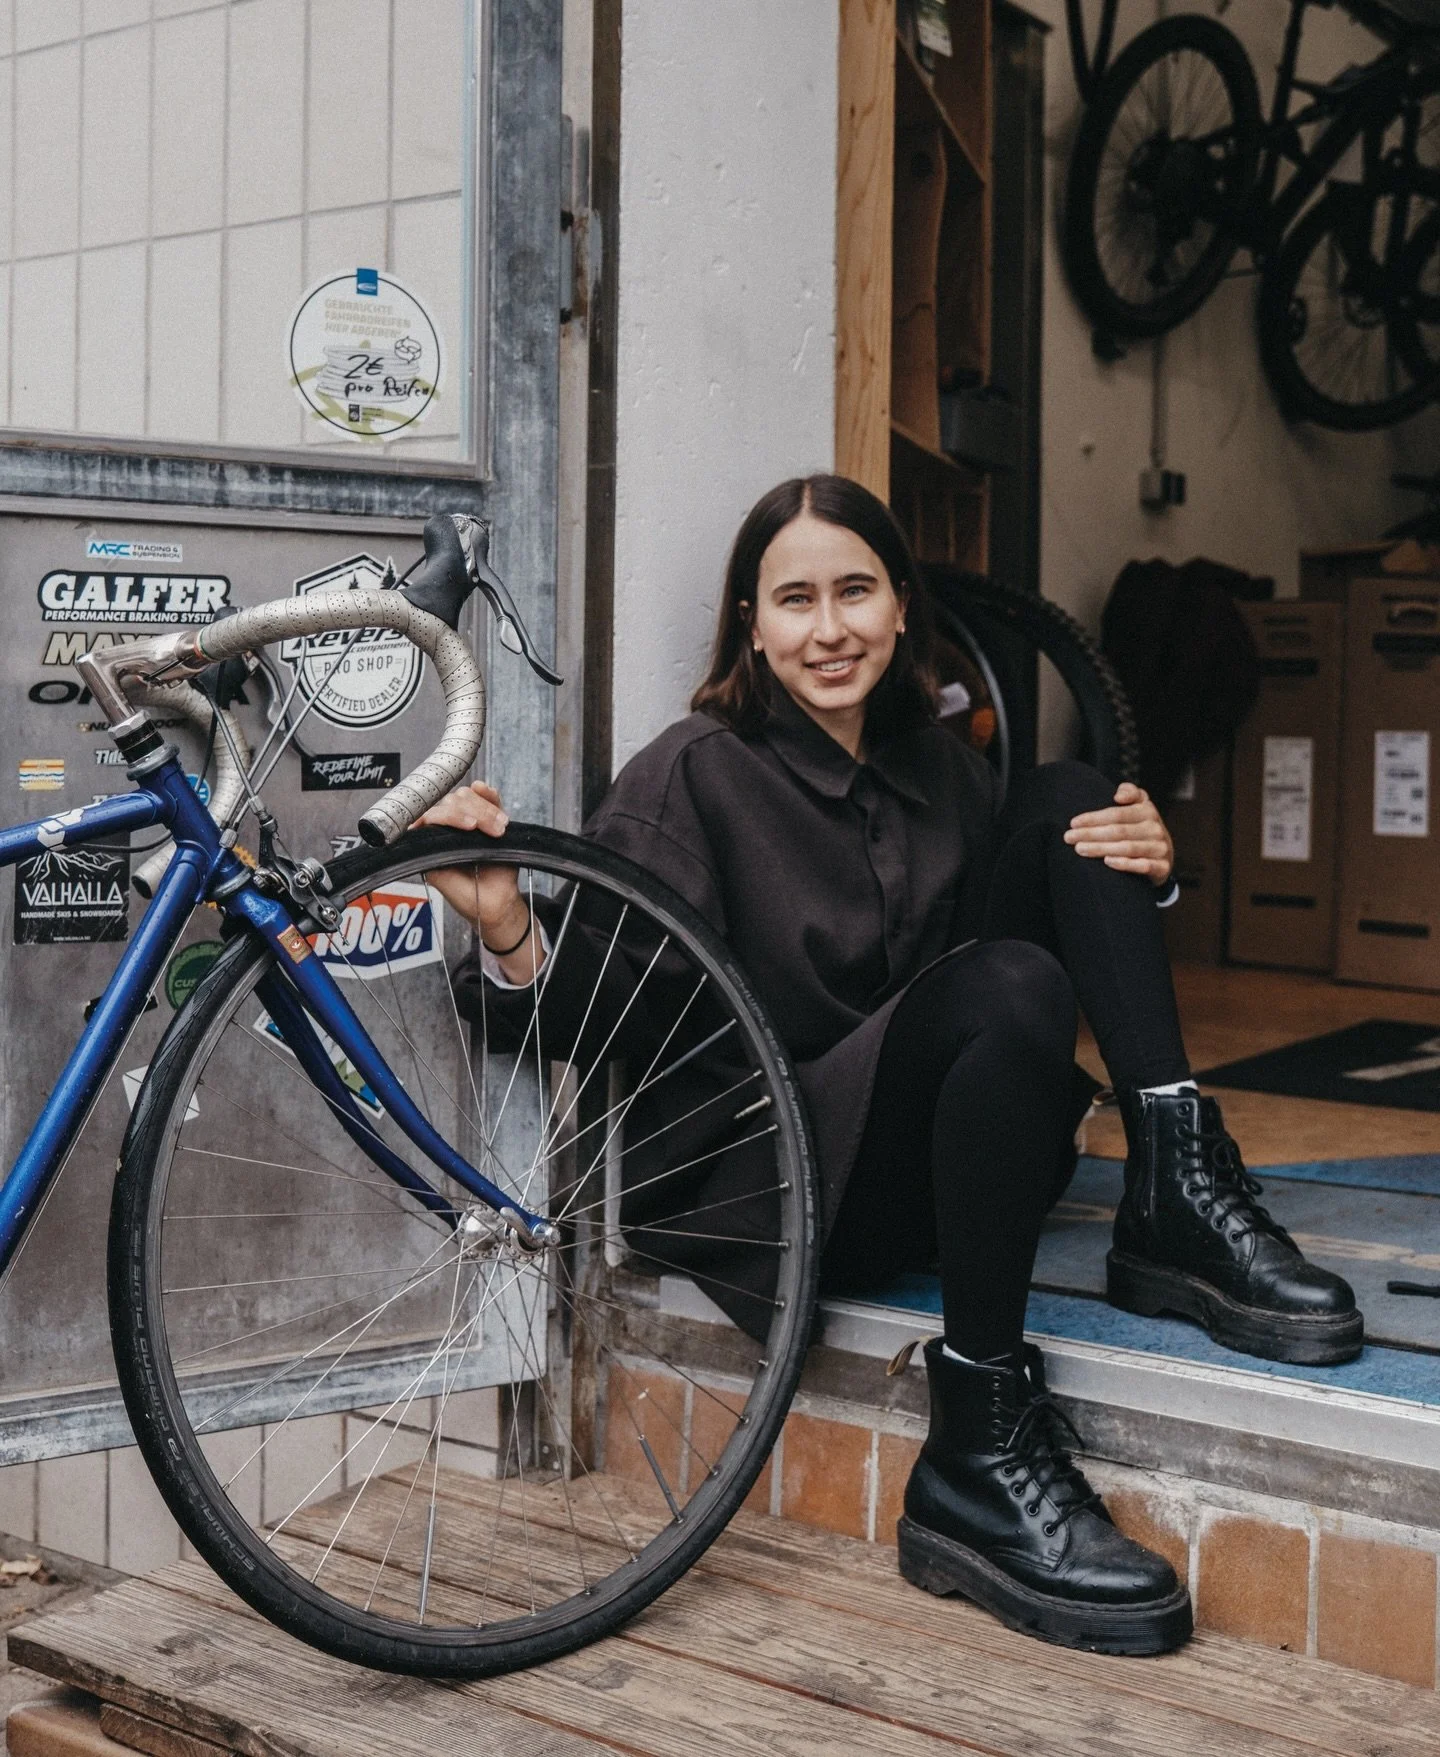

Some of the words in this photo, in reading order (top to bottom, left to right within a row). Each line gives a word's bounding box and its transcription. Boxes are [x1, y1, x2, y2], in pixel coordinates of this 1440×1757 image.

[344, 354, 384, 379] 2€
[345, 382, 374, 398] pro
[90, 543, 130, 556] MRC
[41, 573, 228, 613] GALFER
[45, 610, 125, 621] PERFORMANCE
[128, 612, 179, 623] BRAKING
[357, 655, 394, 672] SHOP
[369, 676, 404, 710] DEALER
[312, 755, 374, 777] REDEFINE
[328, 771, 355, 786] YOUR
[355, 765, 386, 784] LIMIT
[22, 881, 124, 907] VALHALLA
[21, 911, 55, 919] HANDMADE
[80, 910, 123, 918] SNOWBOARDS
[140, 1337, 171, 1432] DURANO
